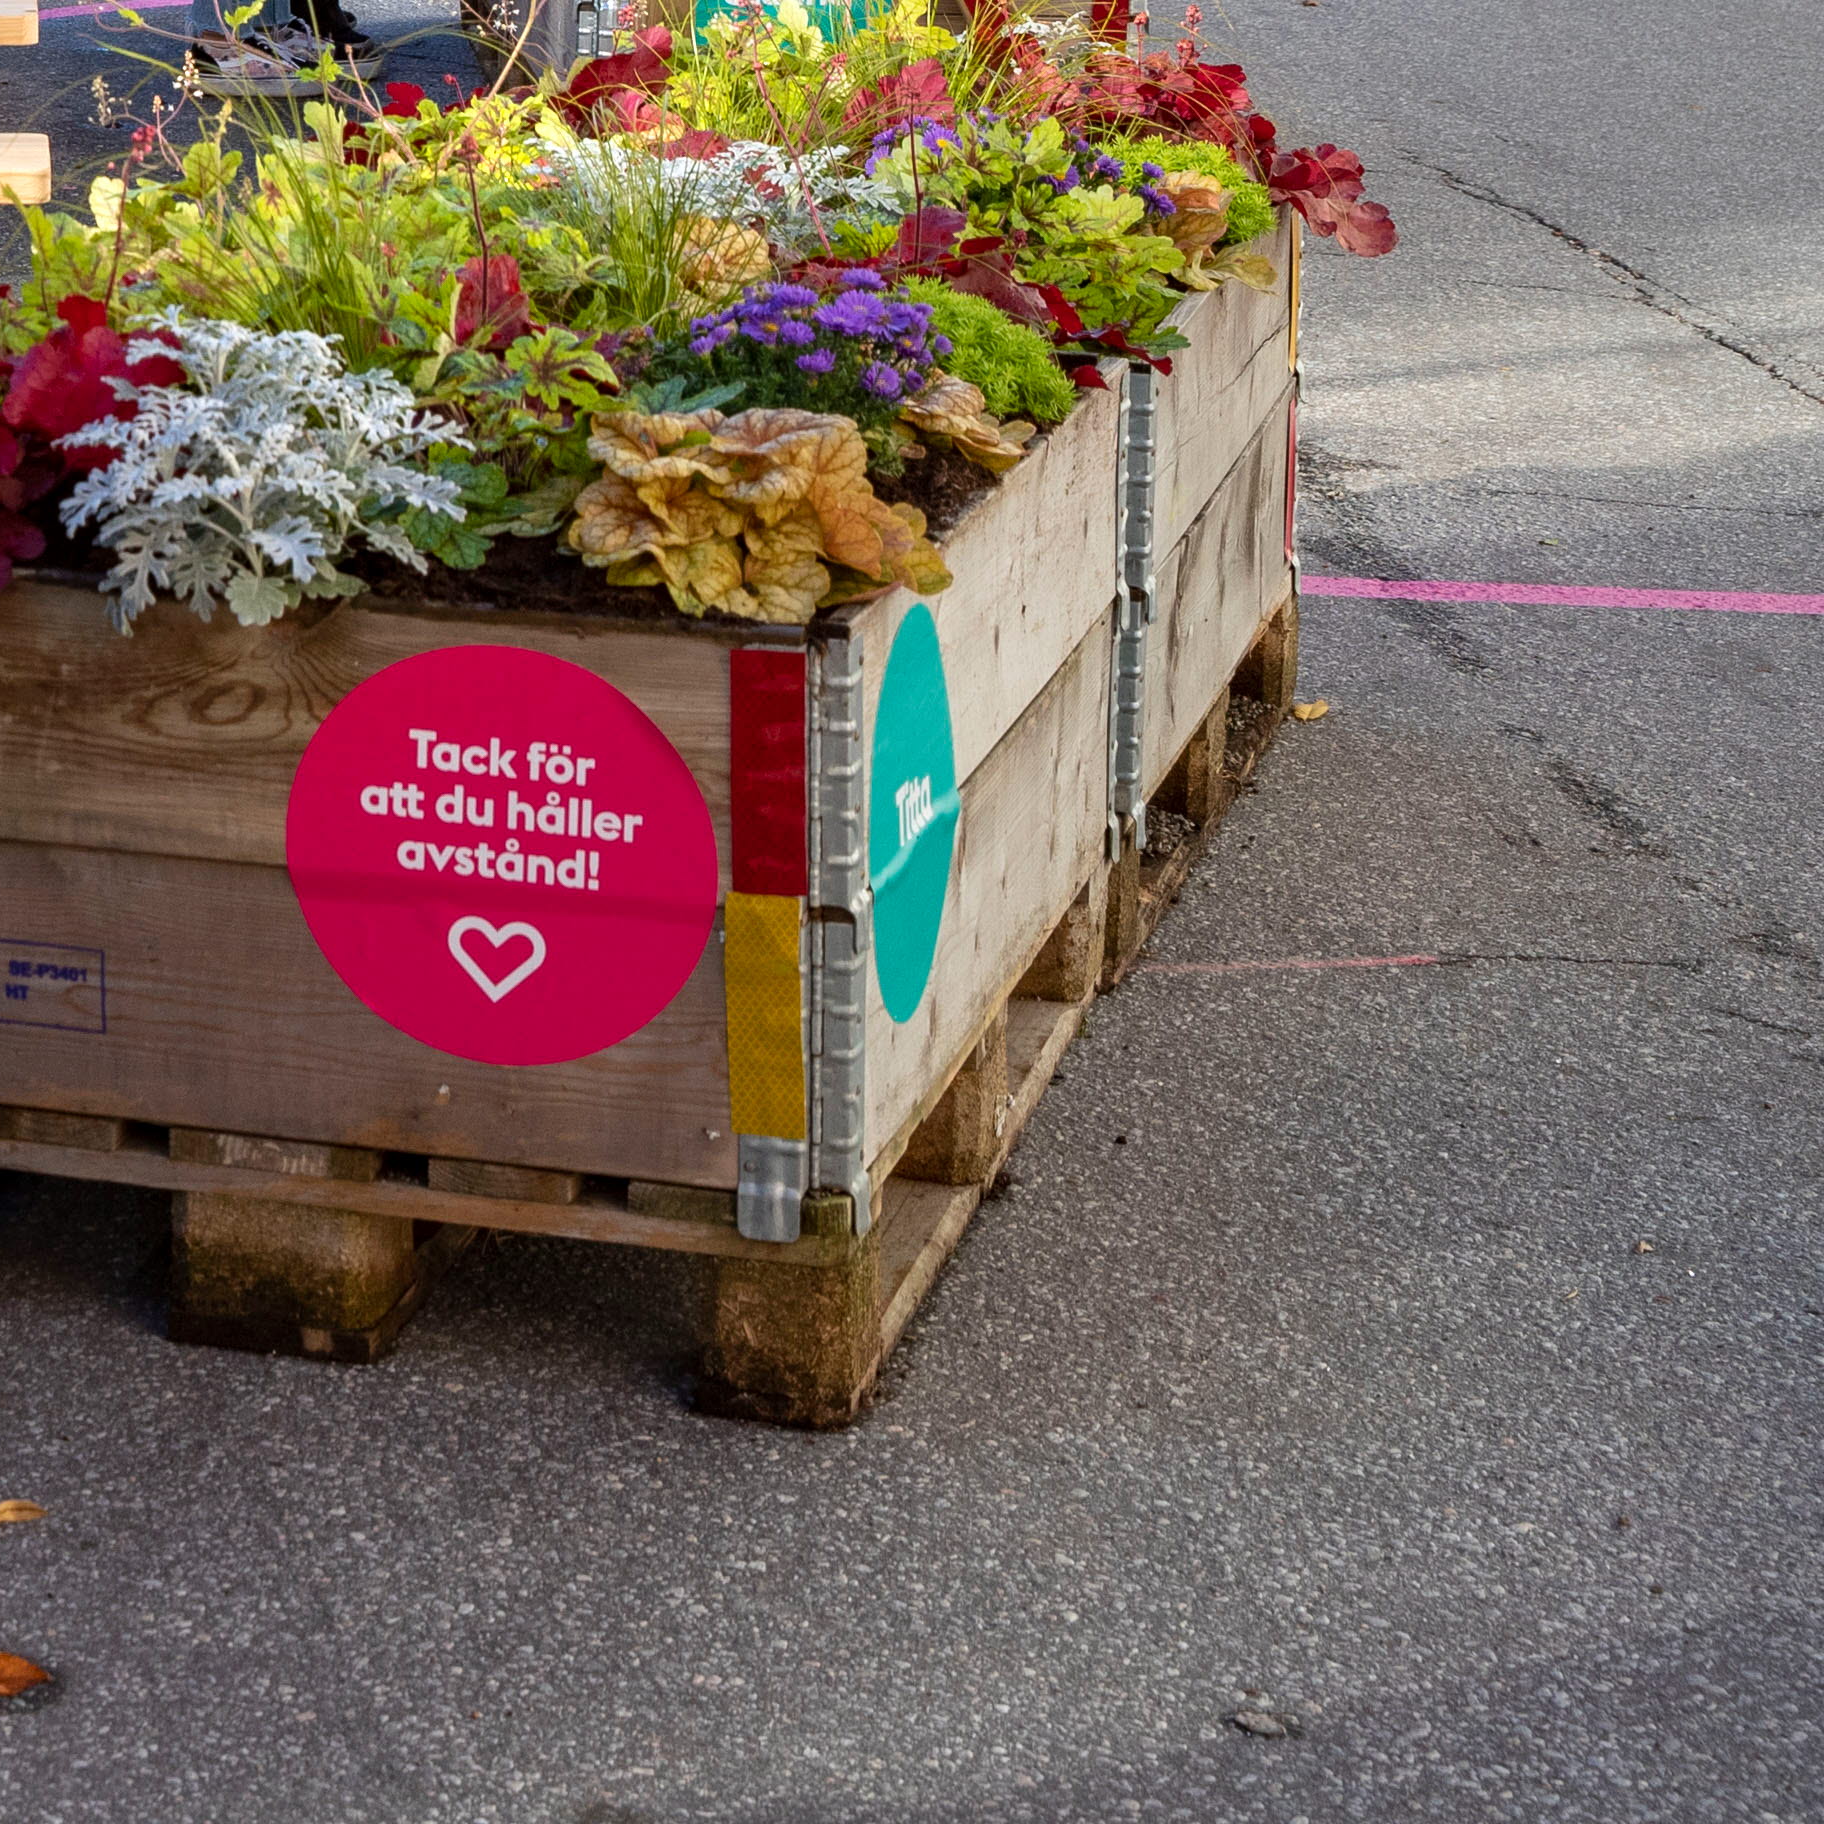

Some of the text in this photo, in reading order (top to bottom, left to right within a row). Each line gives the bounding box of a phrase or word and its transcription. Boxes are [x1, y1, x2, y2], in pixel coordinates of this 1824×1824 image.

[409, 728, 596, 787] Tack för
[360, 781, 643, 843] att du håller
[895, 774, 934, 848] Titta
[396, 838, 600, 891] avstånd!
[5, 983, 29, 1001] HT
